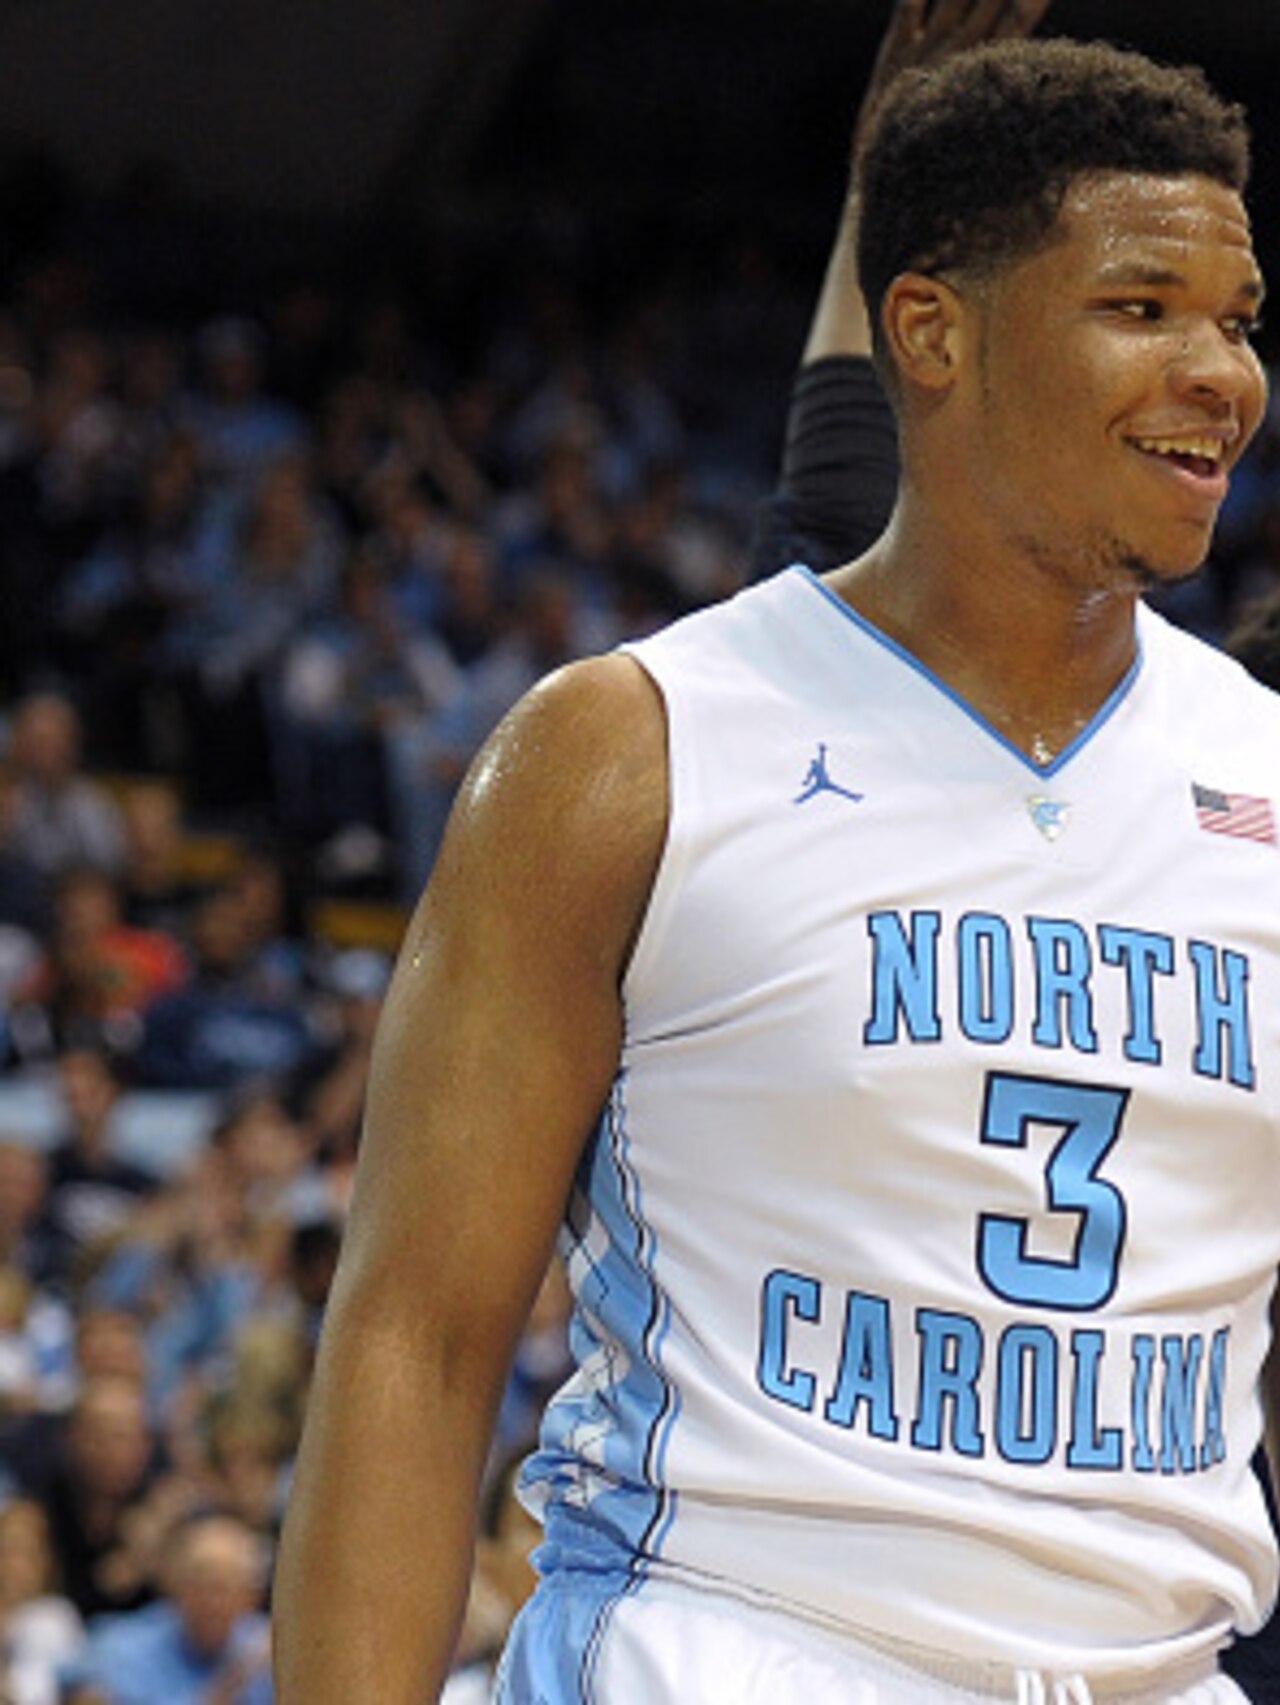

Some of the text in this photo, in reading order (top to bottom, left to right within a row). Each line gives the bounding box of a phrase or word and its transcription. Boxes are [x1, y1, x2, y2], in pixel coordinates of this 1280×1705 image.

[863, 910, 1256, 1092] NORTH
[975, 1069, 1132, 1313] 3
[756, 1268, 1231, 1476] CAROLINA
